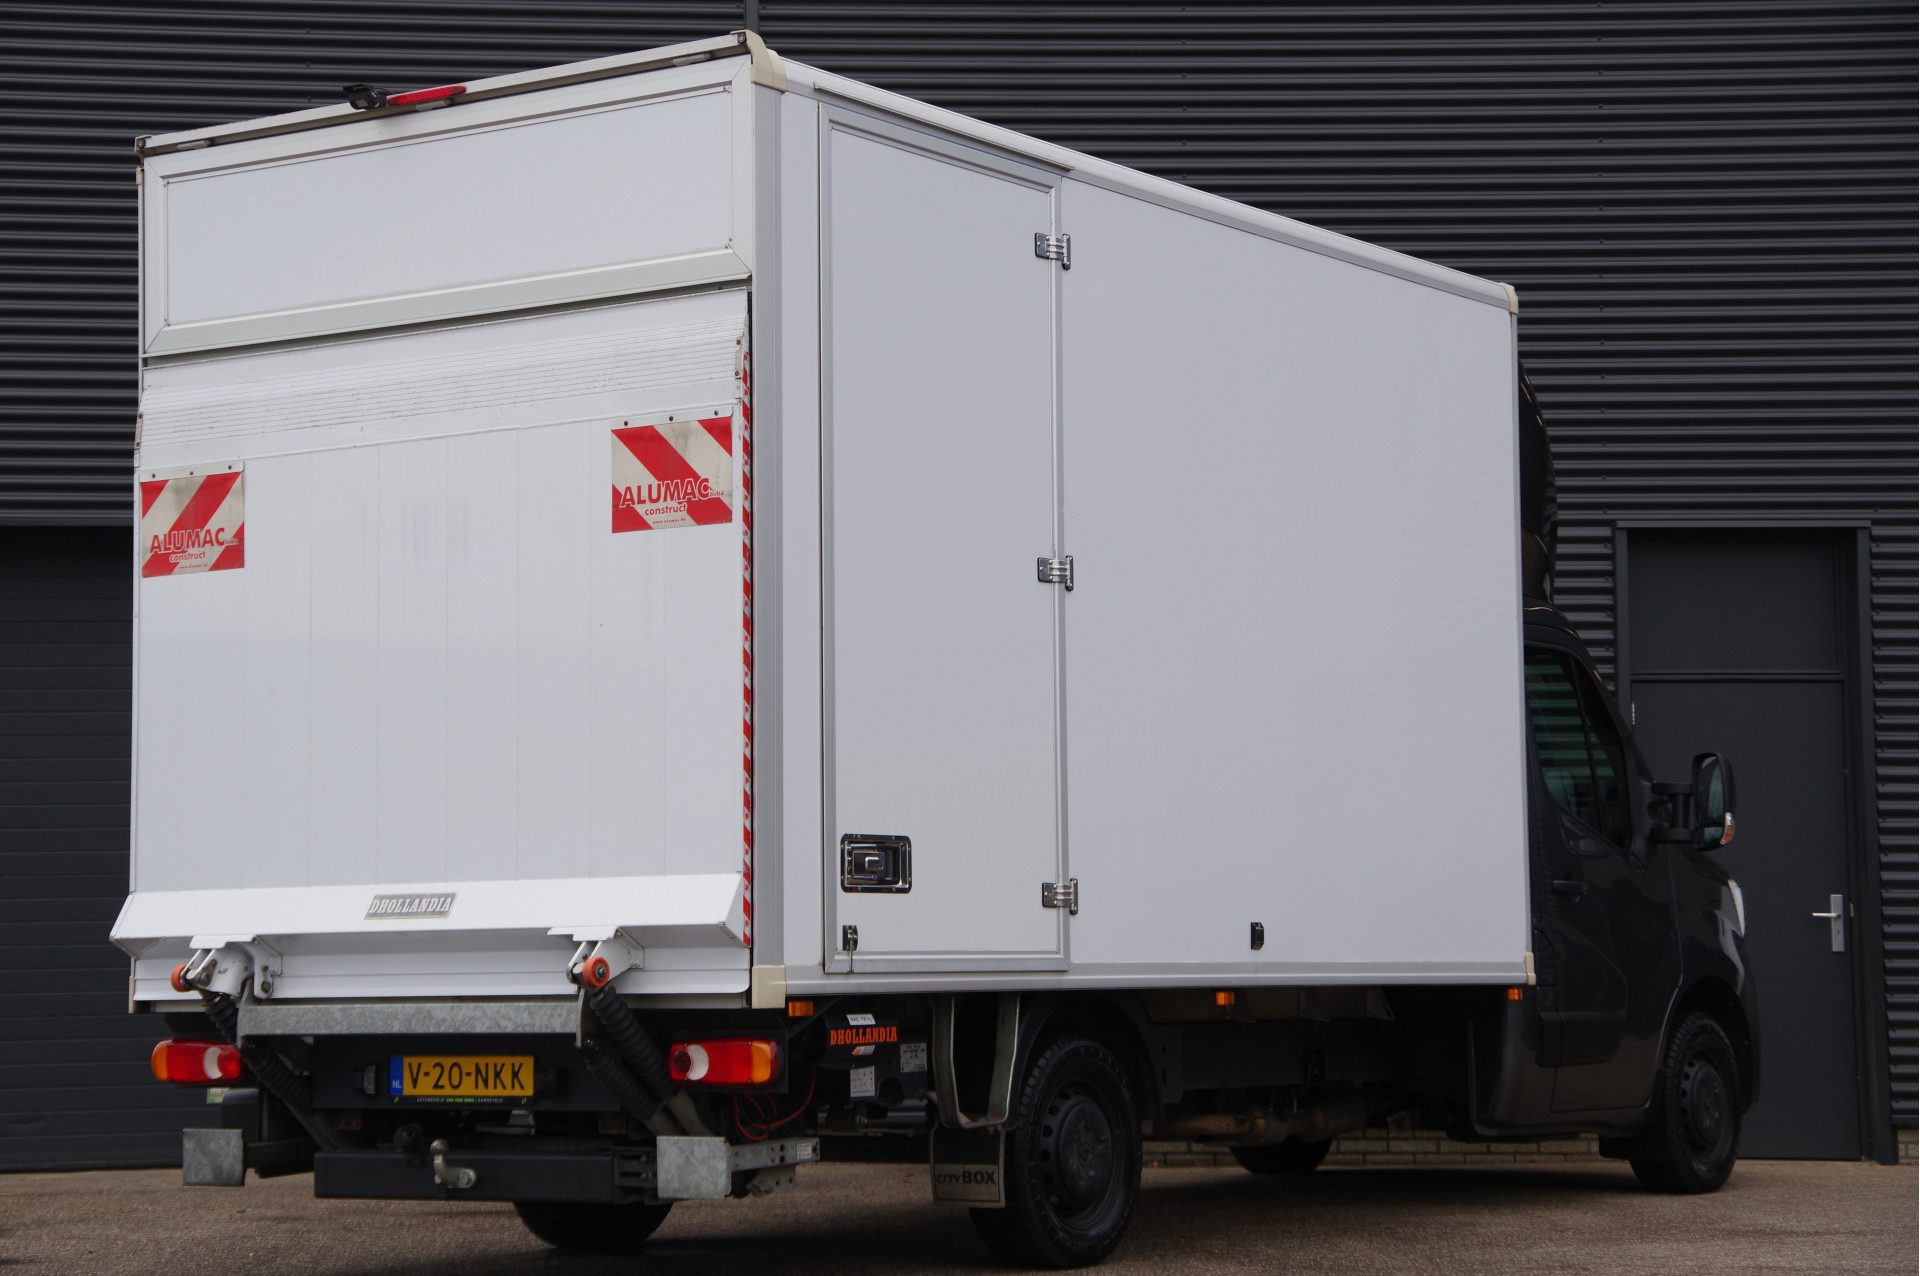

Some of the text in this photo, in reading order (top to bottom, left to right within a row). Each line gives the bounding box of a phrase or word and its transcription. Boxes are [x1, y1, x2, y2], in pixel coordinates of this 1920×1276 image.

[620, 478, 710, 507] ALUMAC
[645, 503, 687, 515] construct
[150, 527, 225, 553] ALUMAC
[169, 551, 206, 562] construct
[367, 897, 453, 914] DHOLLANDIA
[830, 1026, 898, 1046] DHOLLANDIA
[392, 1080, 402, 1089] NL
[408, 1062, 525, 1090] V-20-NKK
